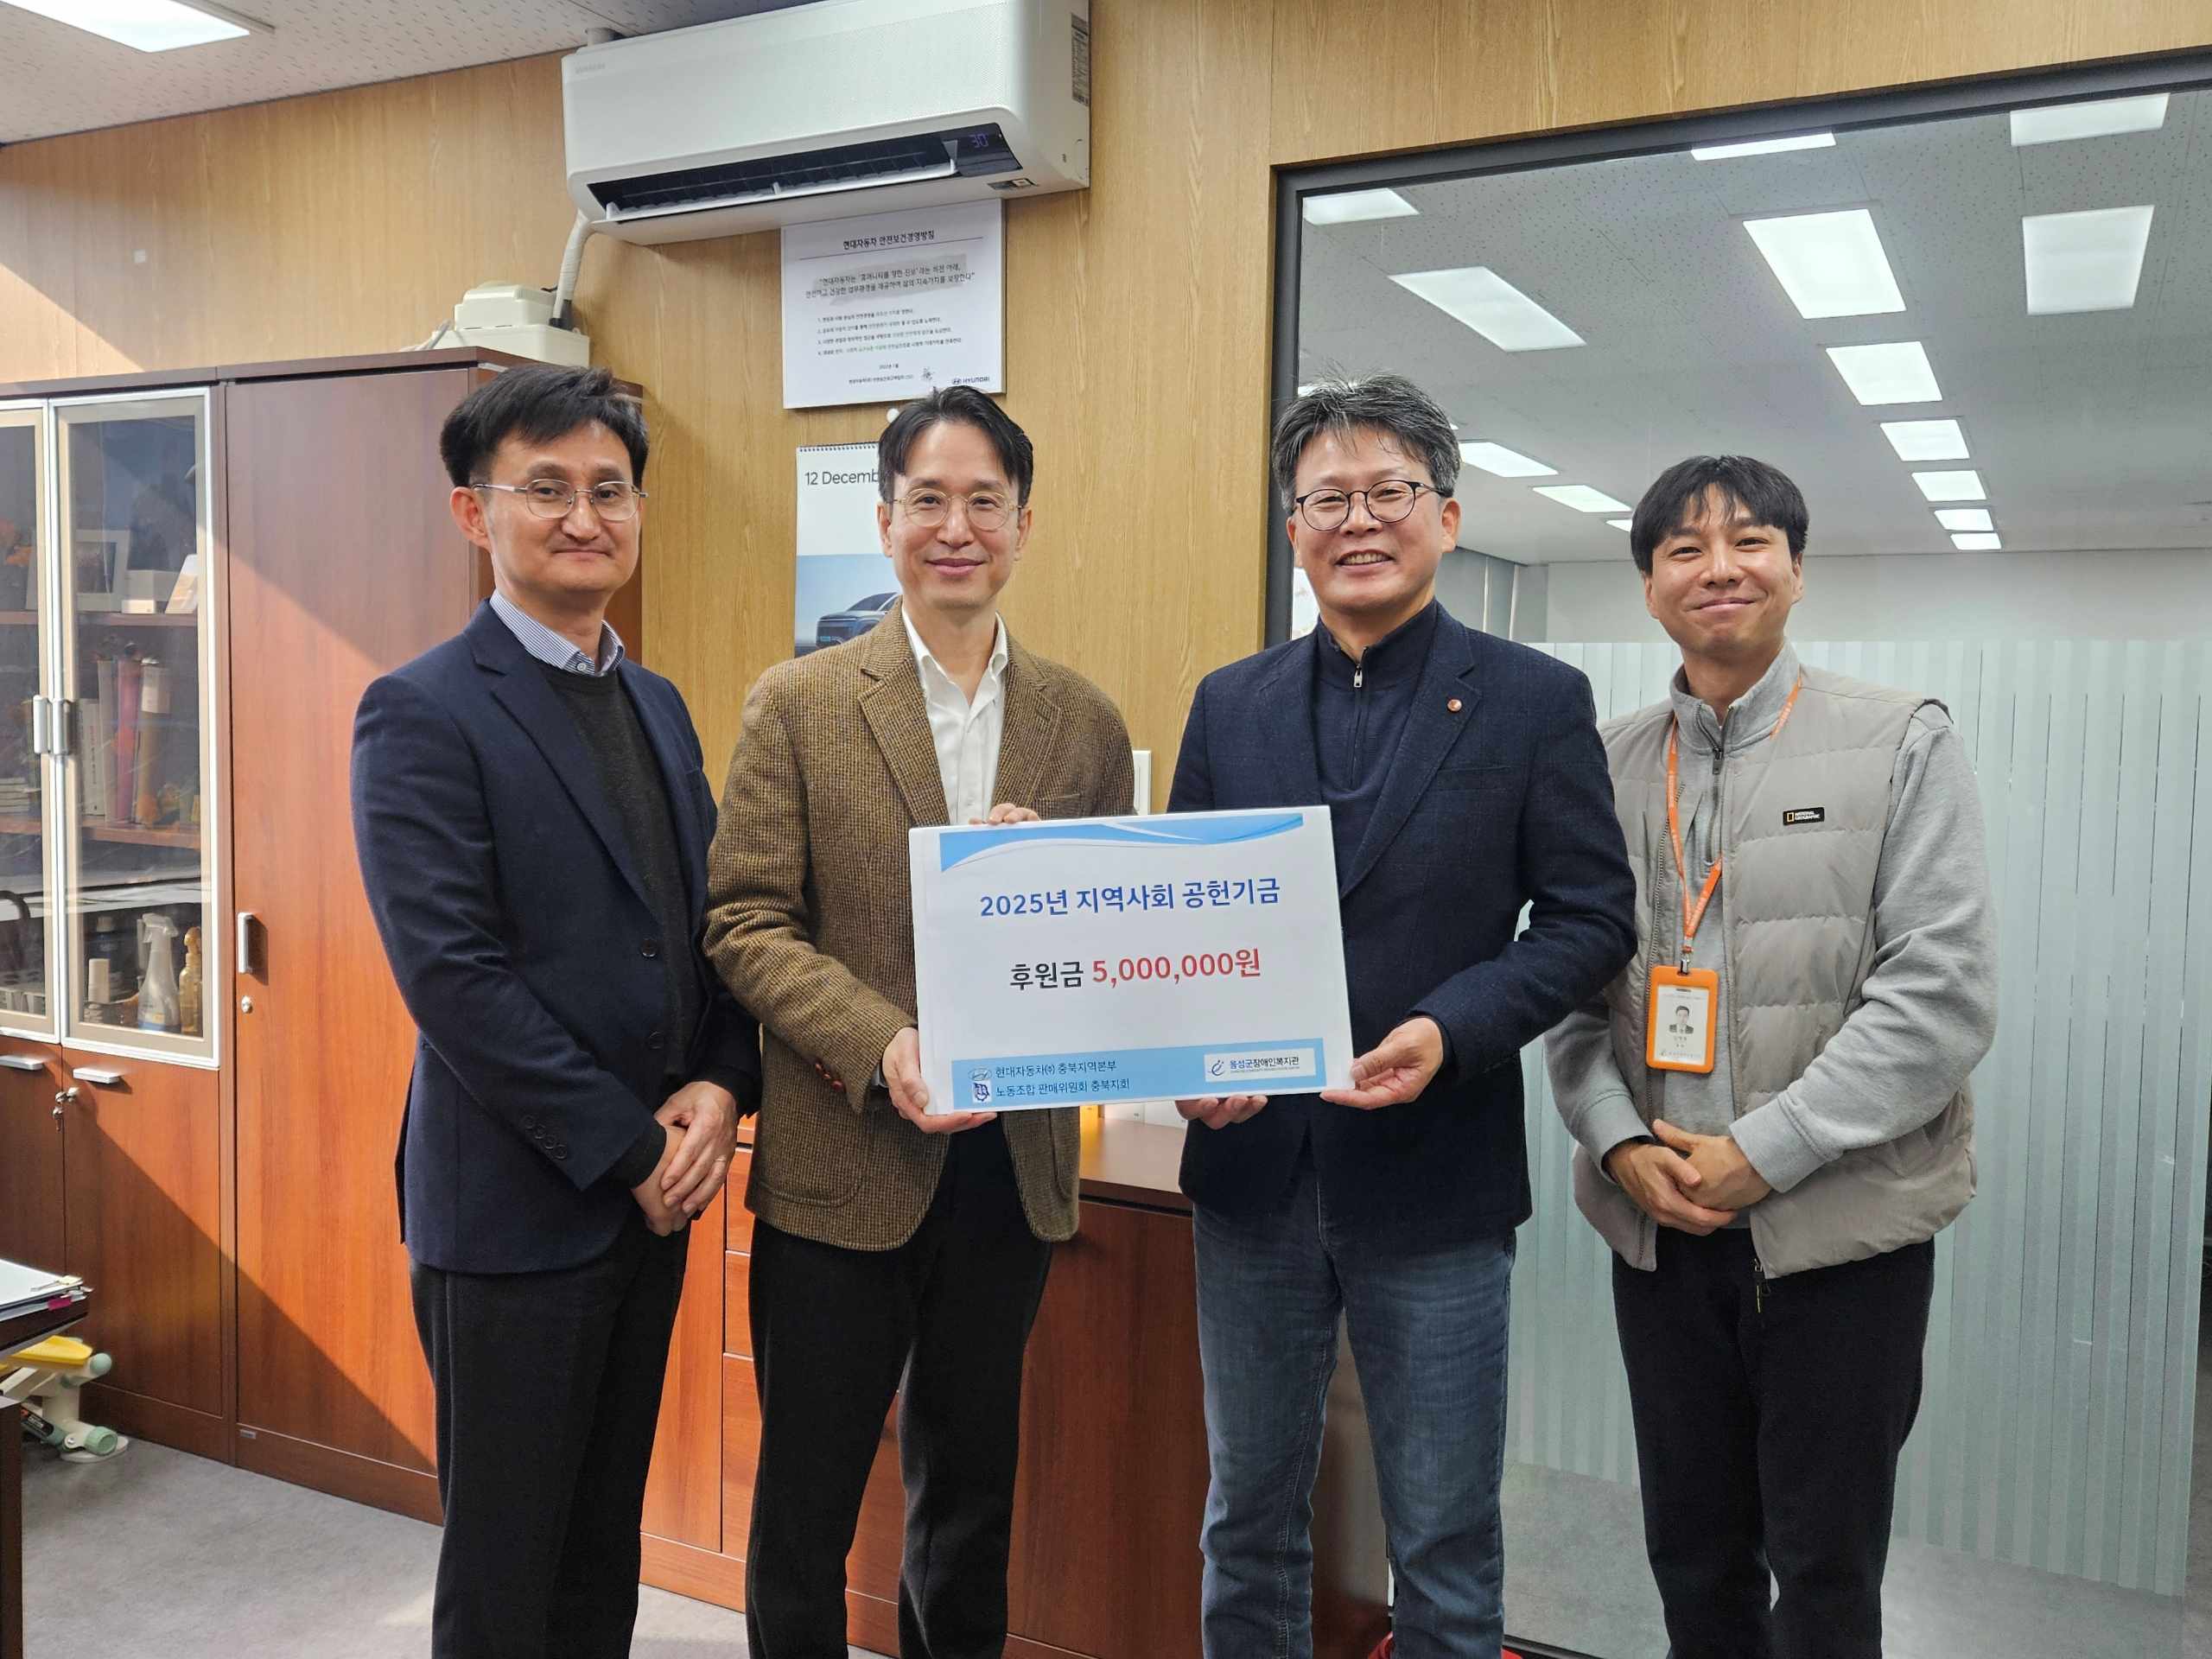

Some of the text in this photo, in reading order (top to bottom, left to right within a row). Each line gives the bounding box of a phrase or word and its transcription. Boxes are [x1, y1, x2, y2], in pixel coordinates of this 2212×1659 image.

[842, 230, 935, 250] 현대자동차 안전보건경영방침
[804, 471, 818, 486] 12
[980, 877, 1281, 917] 2025년 지역사회 공헌기금
[1009, 948, 1262, 991] 후원금 5,000,000원
[1058, 1060, 1117, 1074] 충북지역본부
[1230, 1056, 1300, 1070] 음성군장애인복지관
[996, 1078, 1130, 1097] 노동조합 판매위원회 충북지회
